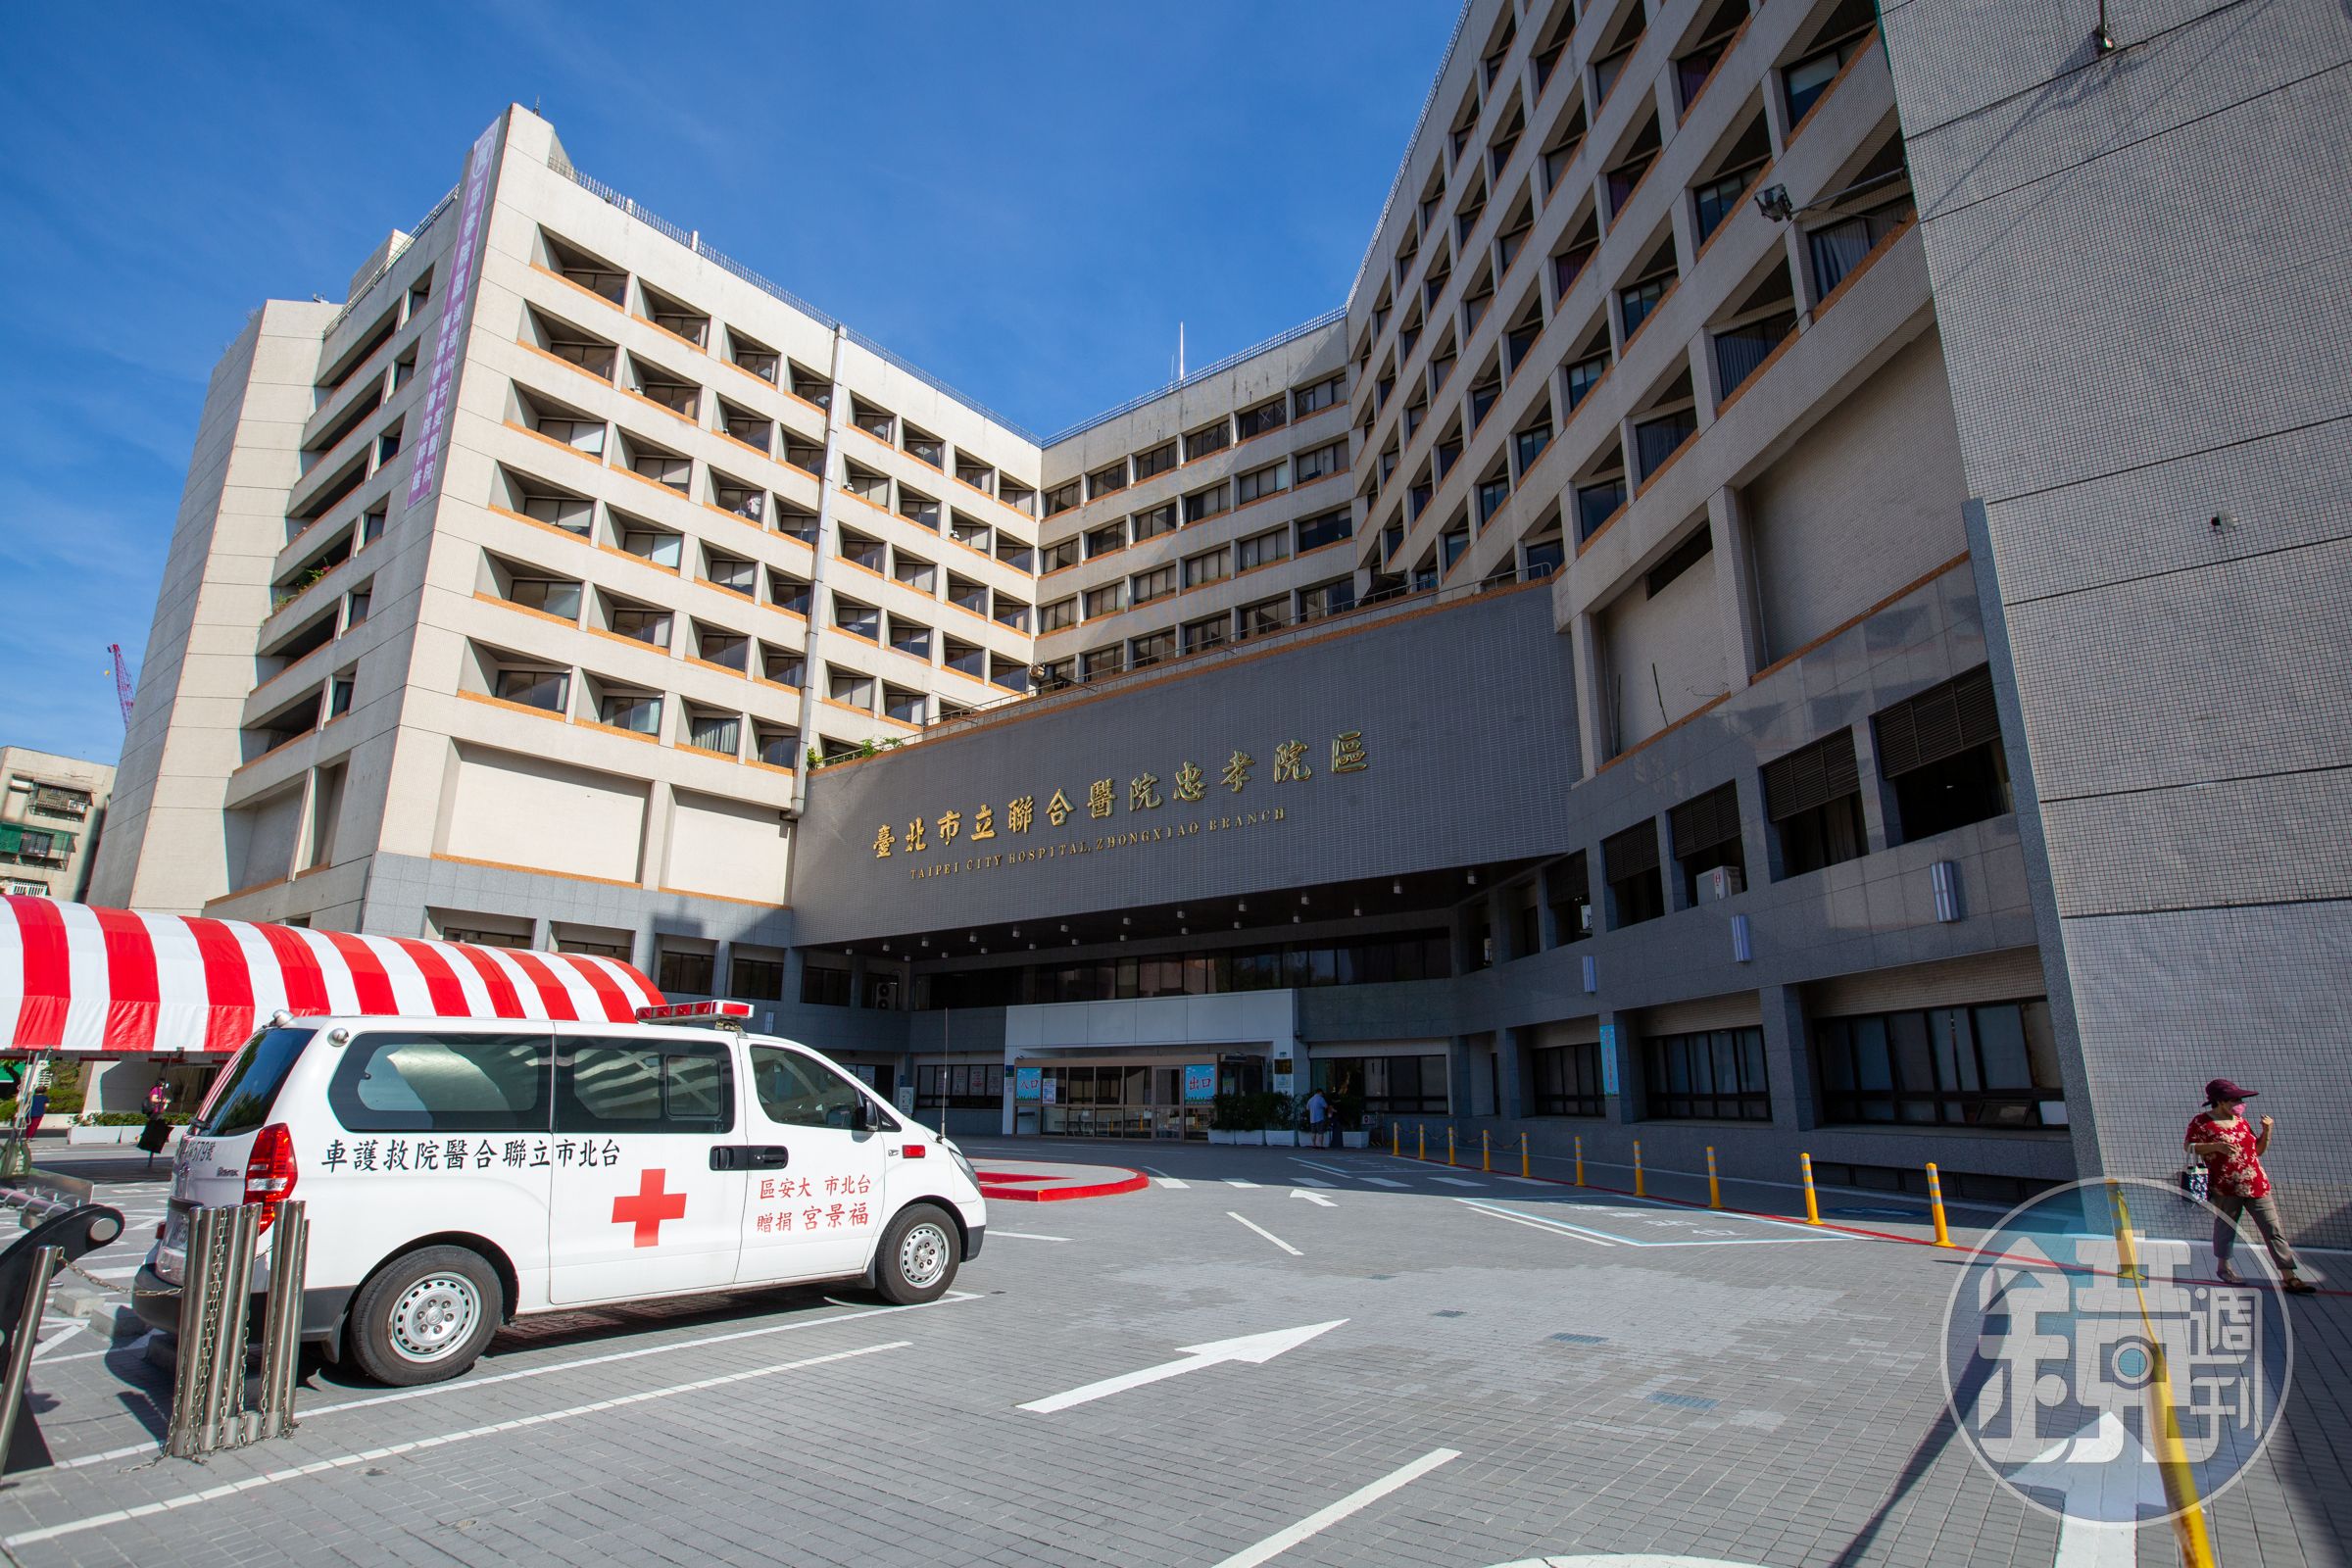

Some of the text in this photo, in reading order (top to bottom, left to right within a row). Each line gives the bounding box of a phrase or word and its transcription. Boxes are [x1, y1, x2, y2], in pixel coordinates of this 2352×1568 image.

[872, 729, 1369, 859] 臺北市立聯合醫院忠孝院區
[910, 861, 959, 880] TAIPEI
[966, 854, 1003, 871] CITY
[1096, 821, 1200, 852] ZHONGXIAO
[1208, 807, 1285, 832] BRANCH
[1020, 1079, 1039, 1090] 入口
[1189, 1076, 1211, 1090] 出口
